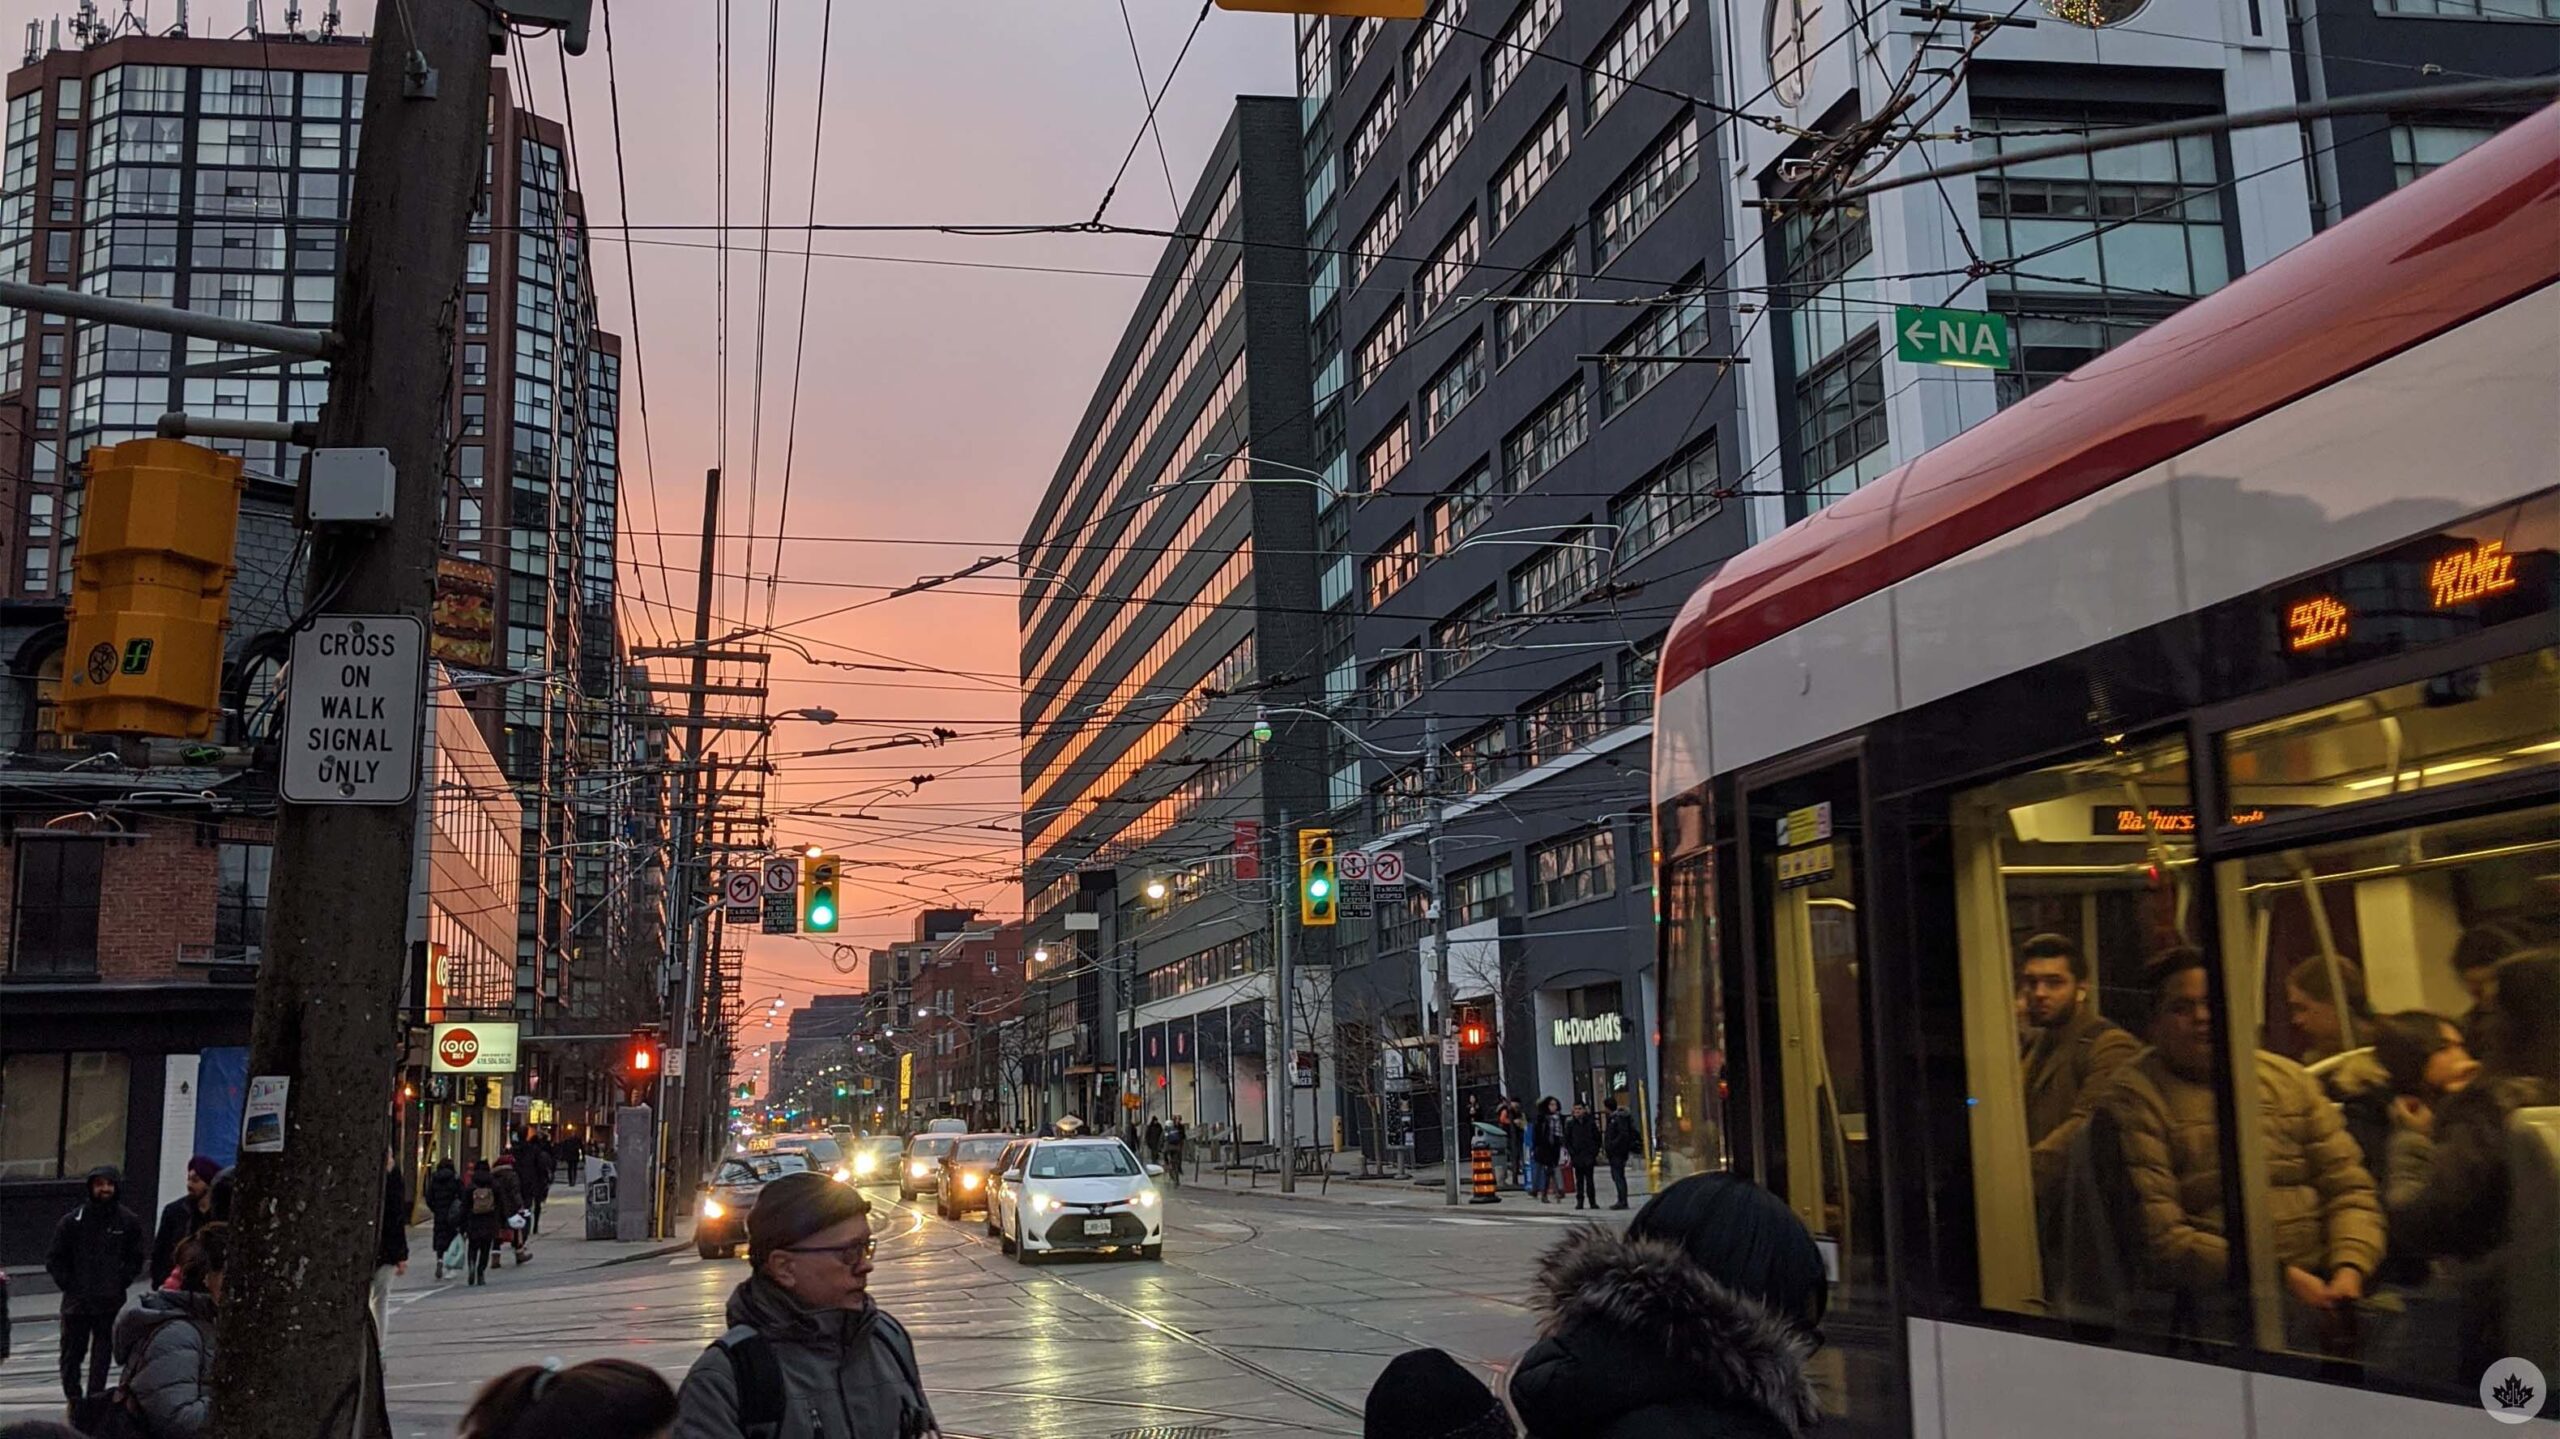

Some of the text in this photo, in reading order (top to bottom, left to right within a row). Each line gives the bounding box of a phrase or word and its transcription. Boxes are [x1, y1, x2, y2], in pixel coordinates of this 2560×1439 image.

[1939, 320, 2001, 357] NA
[2431, 541, 2515, 608] KING
[320, 633, 395, 657] CROSS
[341, 665, 370, 687] ON
[321, 696, 385, 719] WALK
[307, 728, 393, 751] SIGNAL
[318, 760, 380, 783] ONLY
[1554, 1012, 1622, 1045] McDonald's
